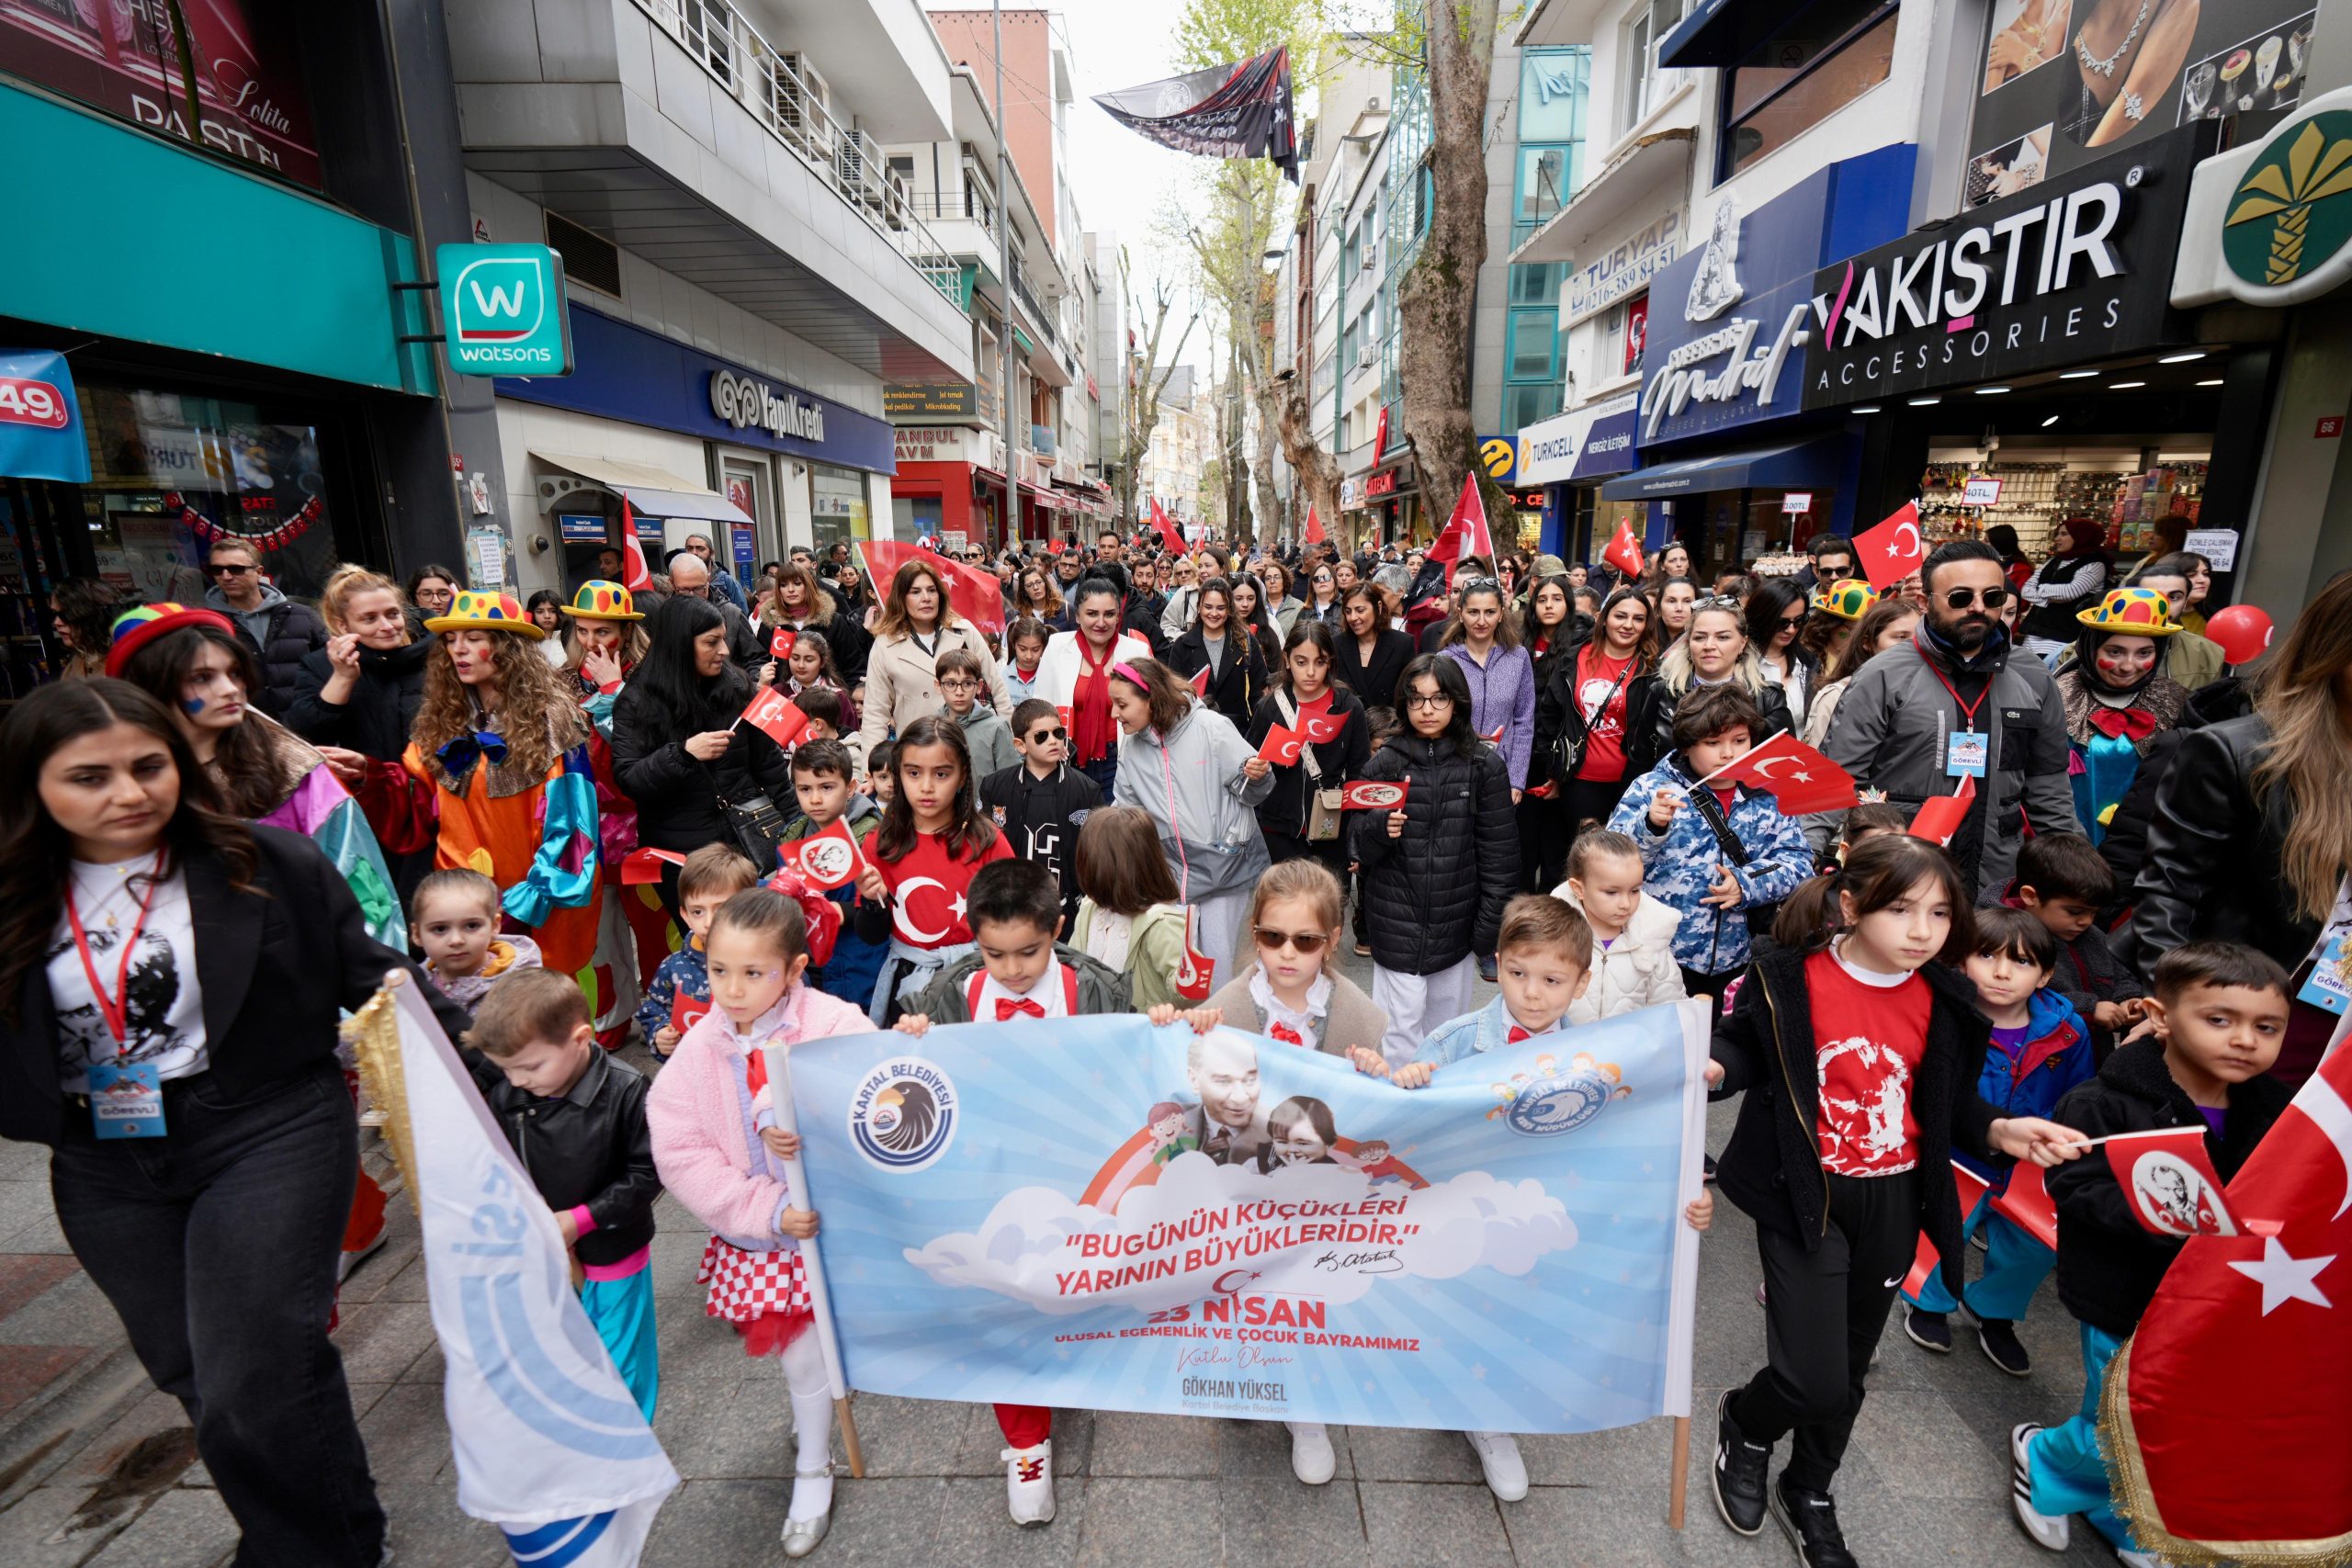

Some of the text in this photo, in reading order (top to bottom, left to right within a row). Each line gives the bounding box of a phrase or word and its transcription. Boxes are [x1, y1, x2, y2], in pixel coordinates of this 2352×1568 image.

[212, 58, 291, 135] Lolita
[1587, 212, 1679, 288] TURYAP
[1811, 182, 2122, 352] YAKIŞTIR
[469, 280, 525, 317] W
[459, 346, 551, 362] watsons
[1816, 298, 2120, 390] ACCESSORIES
[2312, 421, 2335, 434] 66
[895, 446, 935, 459] AVM
[1532, 435, 1574, 462] TURKCELL
[853, 1064, 954, 1120] KARTAL BELEDİYESİ
[1518, 1085, 1552, 1113] KARTAL
[102, 1104, 156, 1116] GÖREVLİ
[1236, 1195, 1409, 1229] KÜÇÜKLERİ
[1056, 1255, 1178, 1296] YARININ
[1147, 1303, 1191, 1325] 23
[1054, 1323, 1421, 1353] ULUSAL EGEMENLİK VE ÇOCUK BAYRAMIMIZ
[1182, 1376, 1288, 1403] GÖKHAN YÜKSEL
[1182, 1400, 1212, 1410] Kartal
[1212, 1401, 1251, 1414] Belediye
